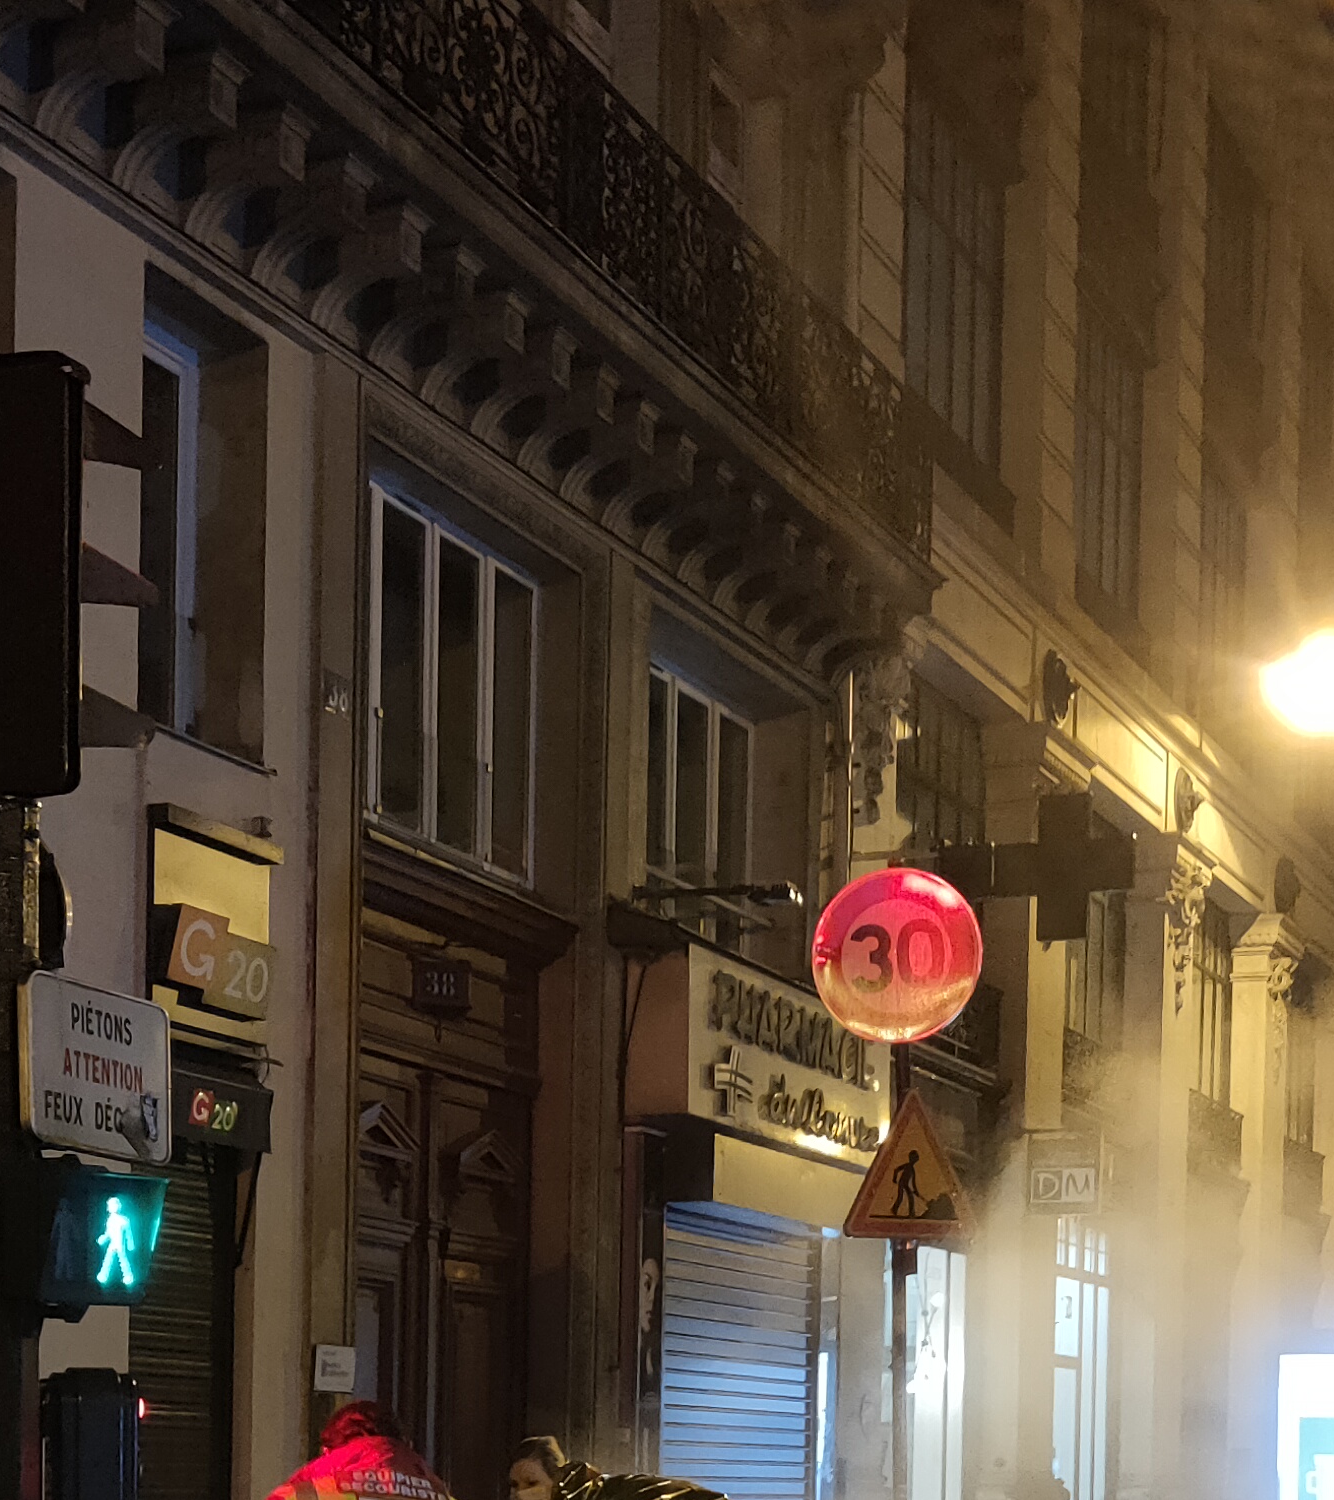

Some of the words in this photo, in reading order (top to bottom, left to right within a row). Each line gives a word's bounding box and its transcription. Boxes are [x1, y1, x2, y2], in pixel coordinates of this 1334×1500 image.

[179, 918, 267, 1004] G20
[850, 918, 946, 993] 30
[70, 1000, 133, 1046] PIÉTONS
[63, 1047, 143, 1094] ATTENTION
[44, 1089, 84, 1126] FEUX
[94, 1097, 125, 1134] DÉC
[193, 1091, 236, 1132] G20
